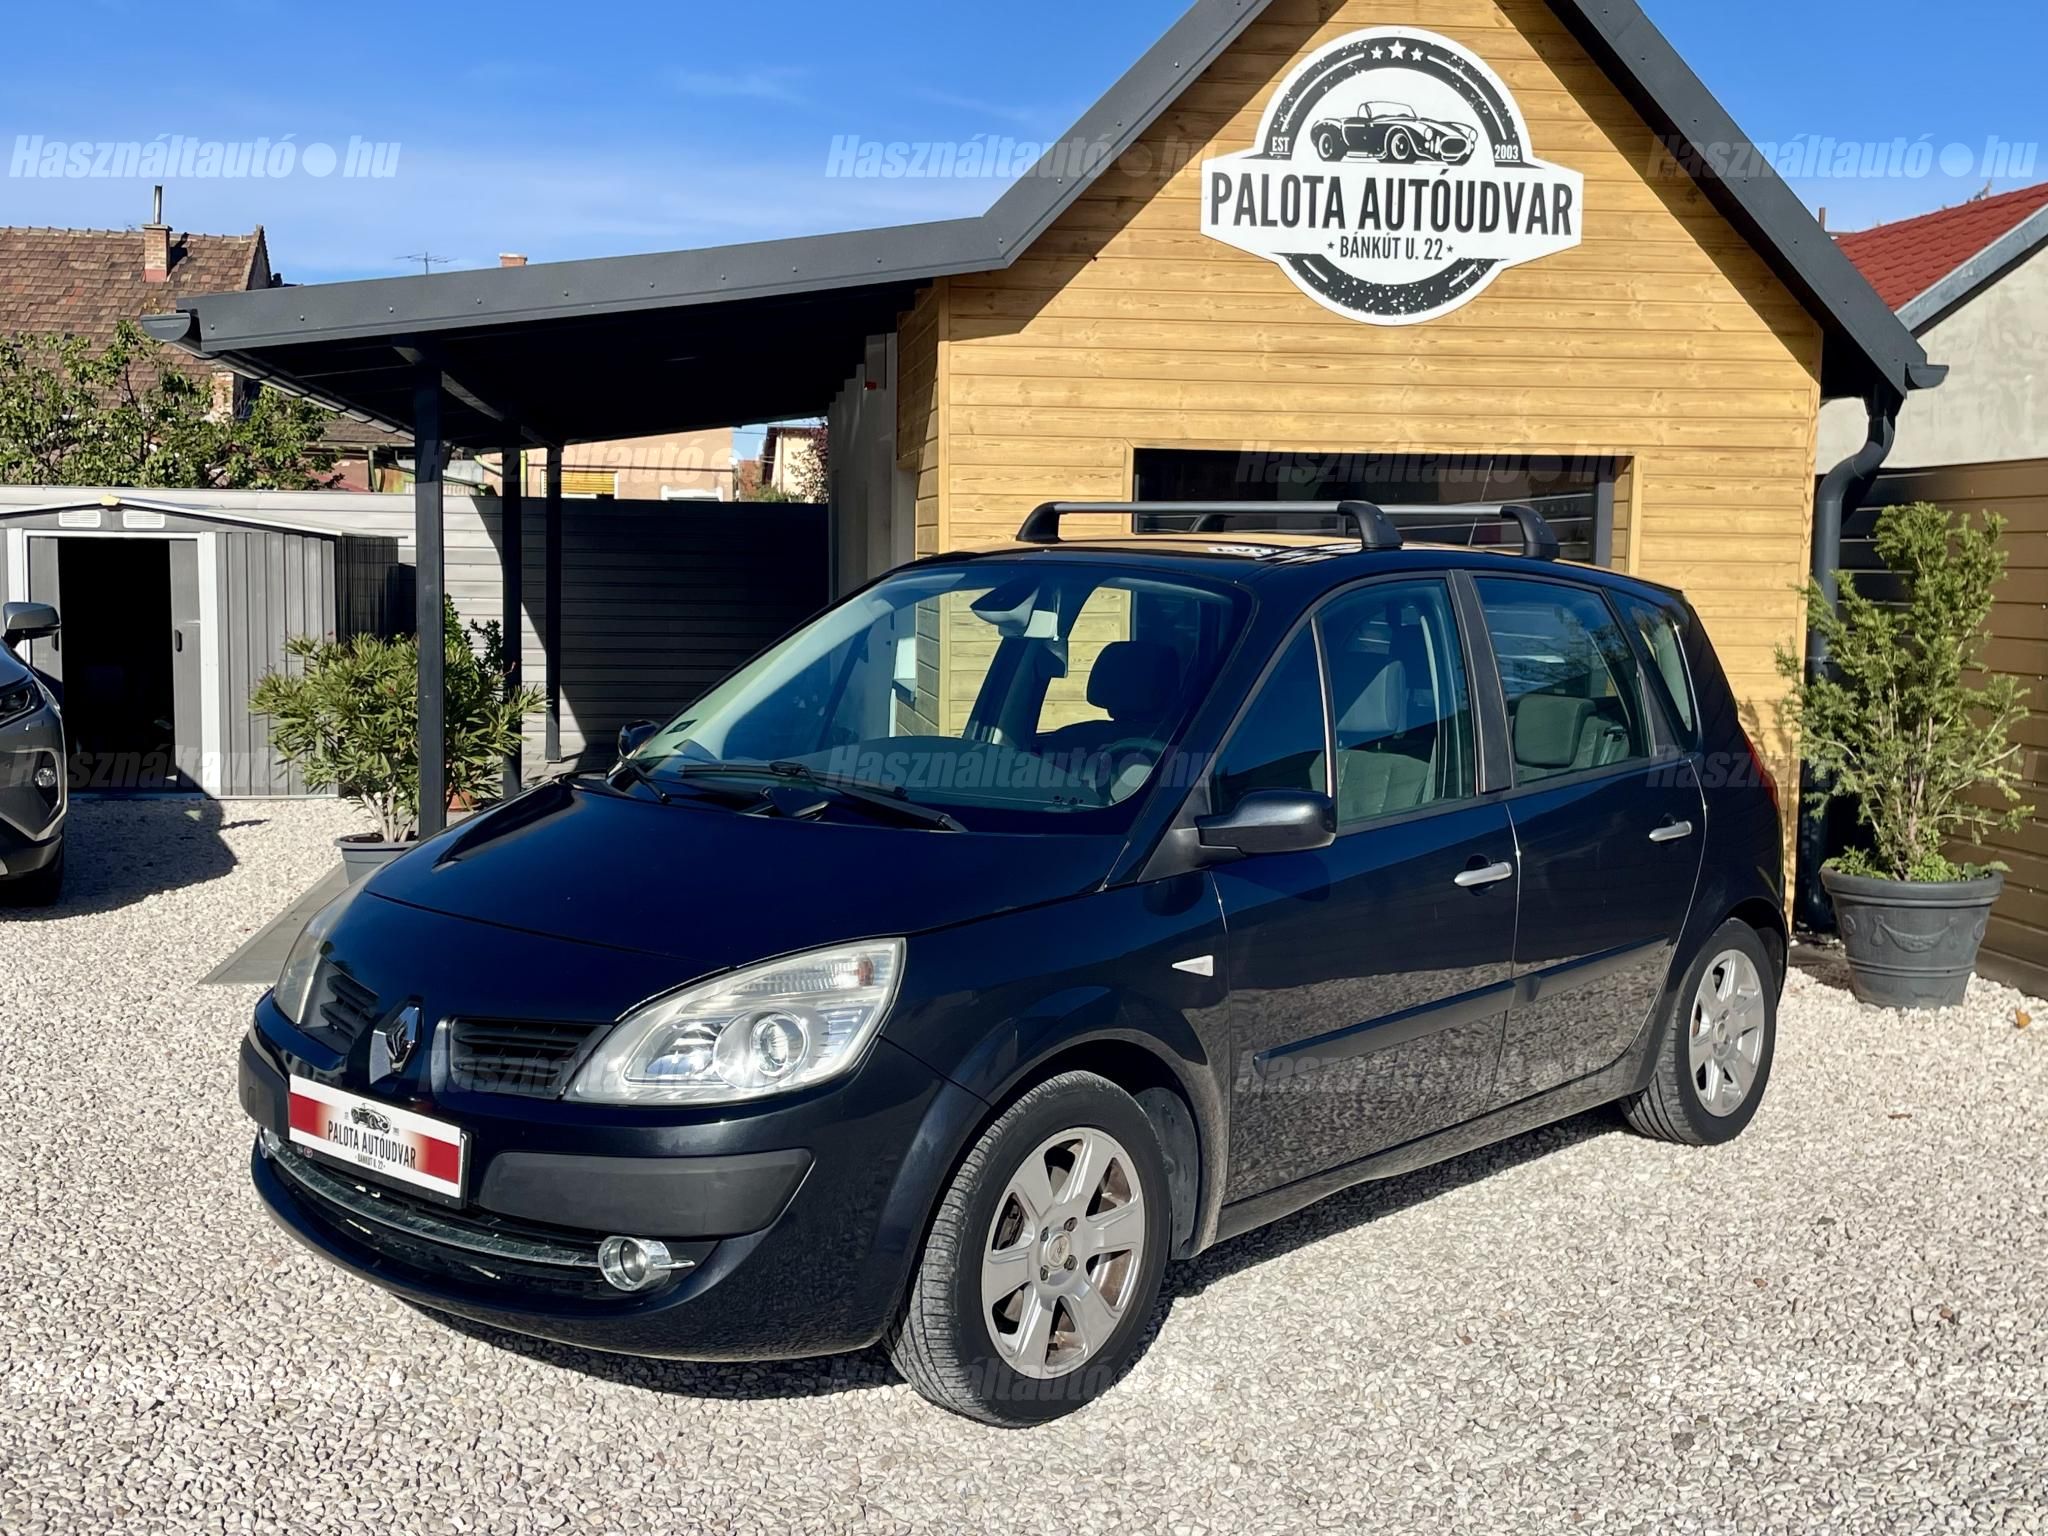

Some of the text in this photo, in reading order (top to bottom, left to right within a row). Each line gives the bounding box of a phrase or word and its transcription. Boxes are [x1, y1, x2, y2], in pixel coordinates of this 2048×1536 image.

[1271, 136, 1290, 153] EST
[1494, 144, 1519, 161] 2003
[1210, 168, 1573, 237] PALOTA AUTÓUDVAR
[1339, 231, 1443, 260] BÁNKÚT U. 22
[327, 1119, 417, 1170] PALOTA AUTÓUDVAR
